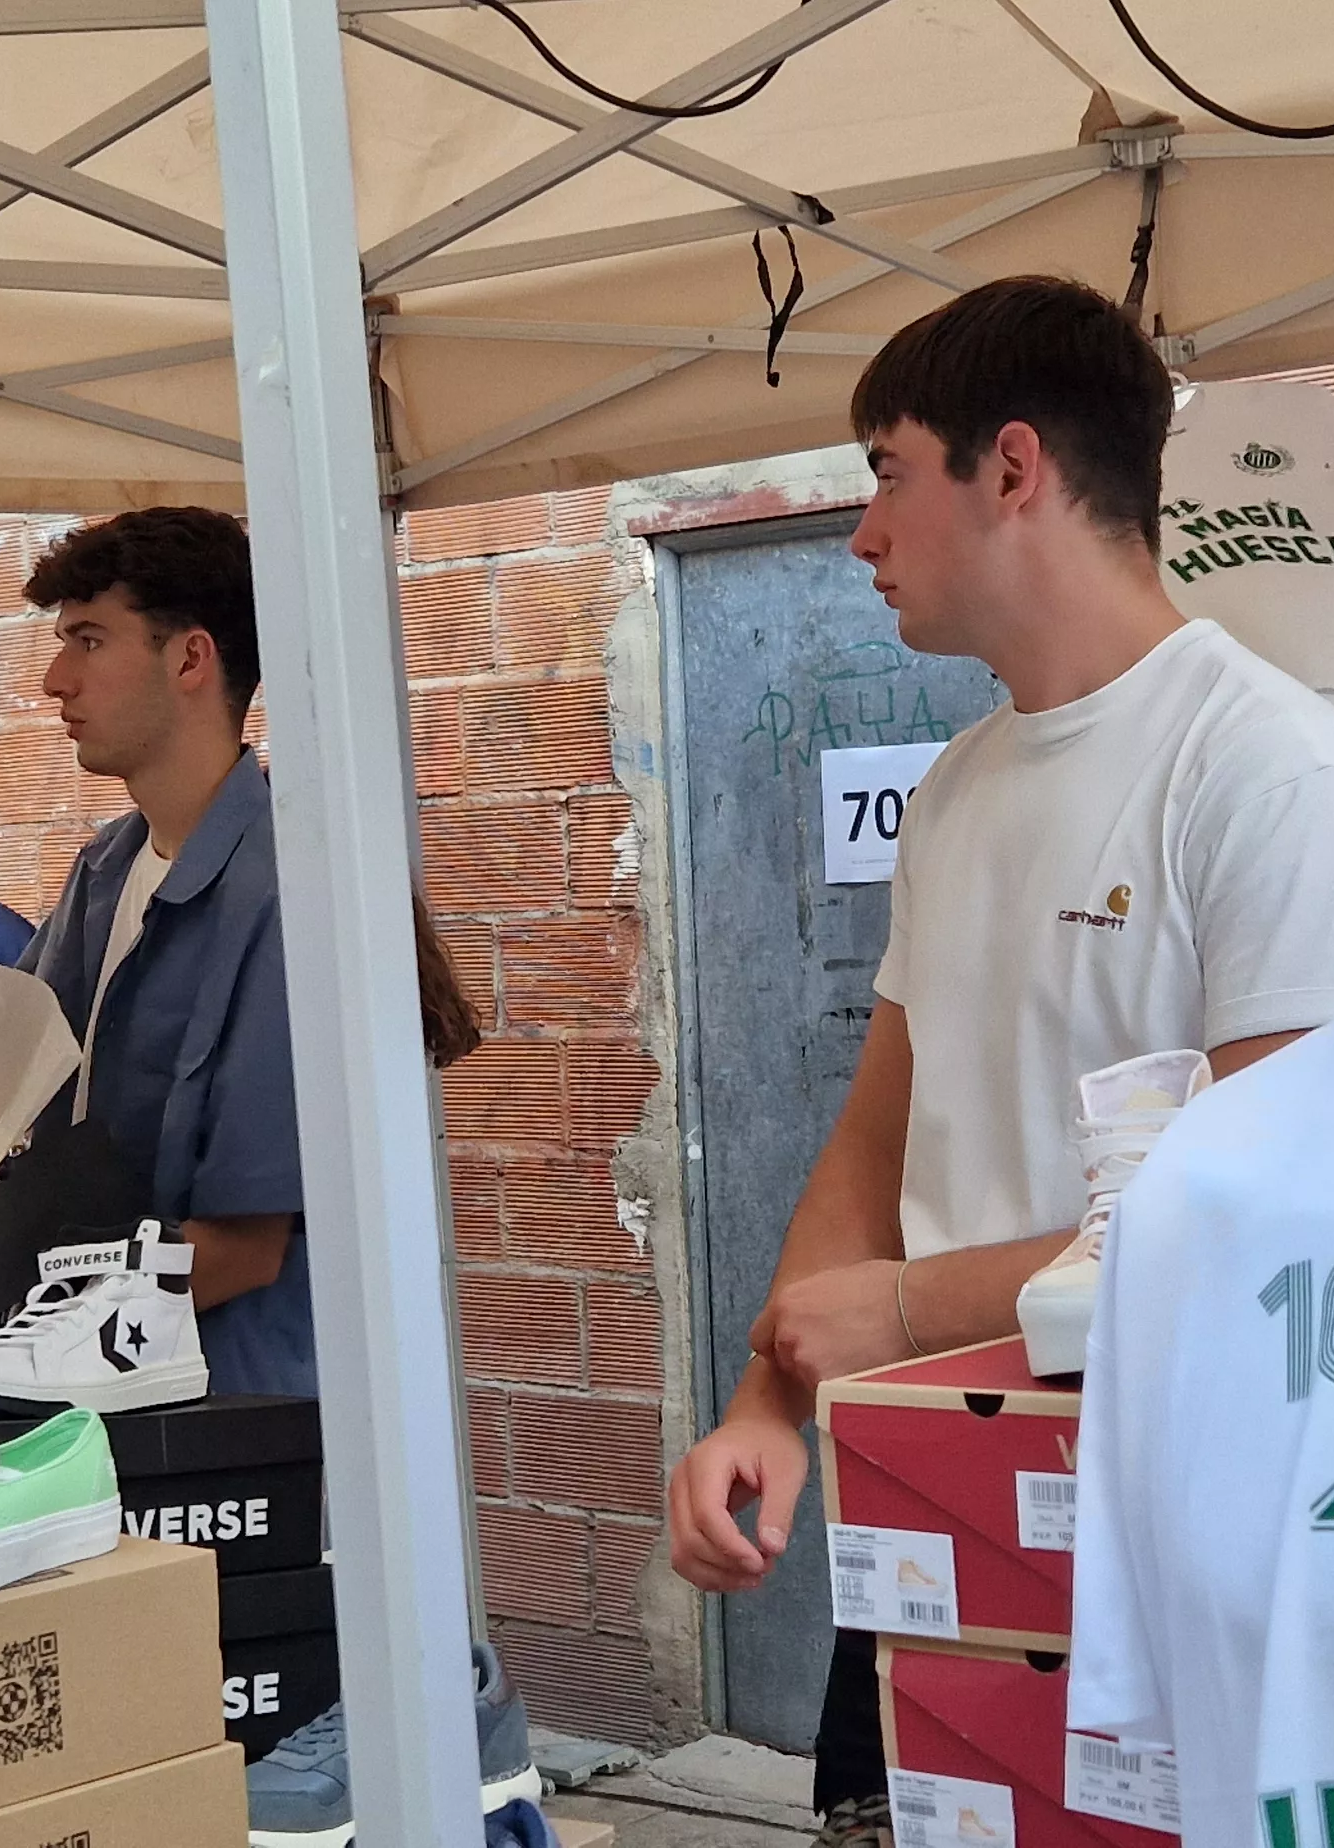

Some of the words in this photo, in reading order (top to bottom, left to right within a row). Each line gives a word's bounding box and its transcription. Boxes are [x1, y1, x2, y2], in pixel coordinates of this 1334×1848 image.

[842, 786, 919, 842] 70
[1058, 910, 1126, 931] carhartt
[44, 1251, 122, 1272] CONVERSE
[124, 1498, 269, 1544] VERSE
[222, 1672, 280, 1719] SE
